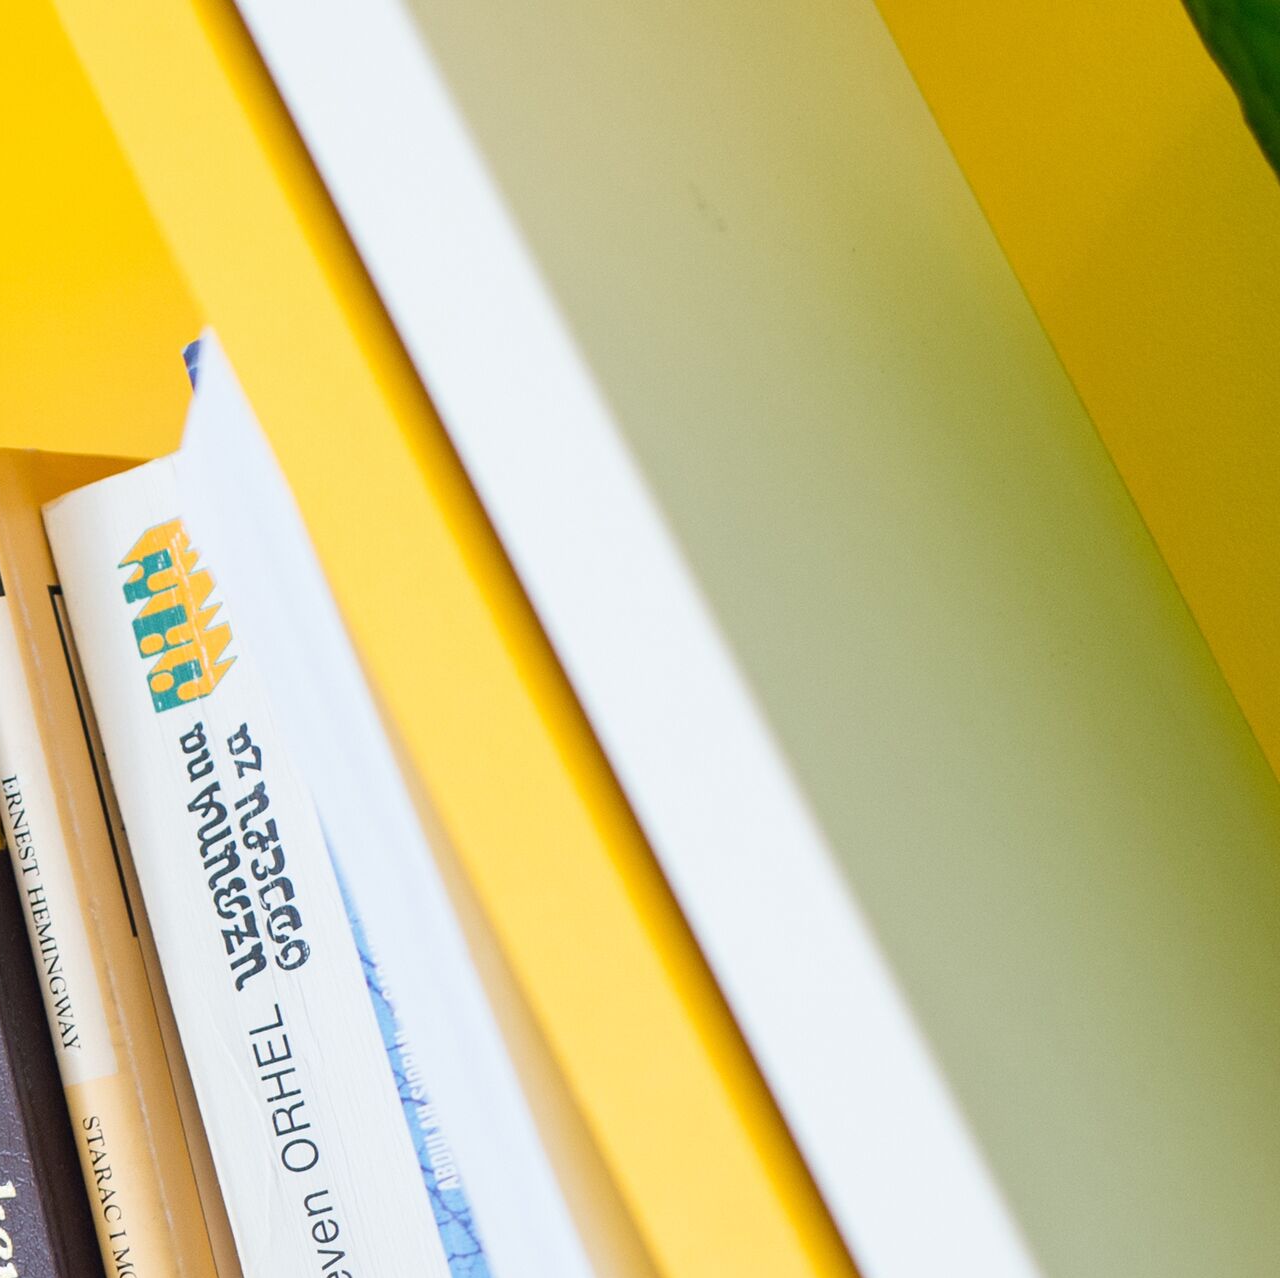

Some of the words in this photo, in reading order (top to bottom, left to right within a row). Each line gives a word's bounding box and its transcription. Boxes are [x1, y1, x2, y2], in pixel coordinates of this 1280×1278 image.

[179, 721, 214, 783] na
[226, 722, 263, 779] za
[1, 774, 40, 877] ERNEST
[27, 885, 81, 1050] HEMINGWAY
[186, 781, 268, 992] UZBUNA
[248, 1001, 320, 1173] ORHEL
[82, 1115, 122, 1224] STARAC
[109, 1230, 127, 1240] I
